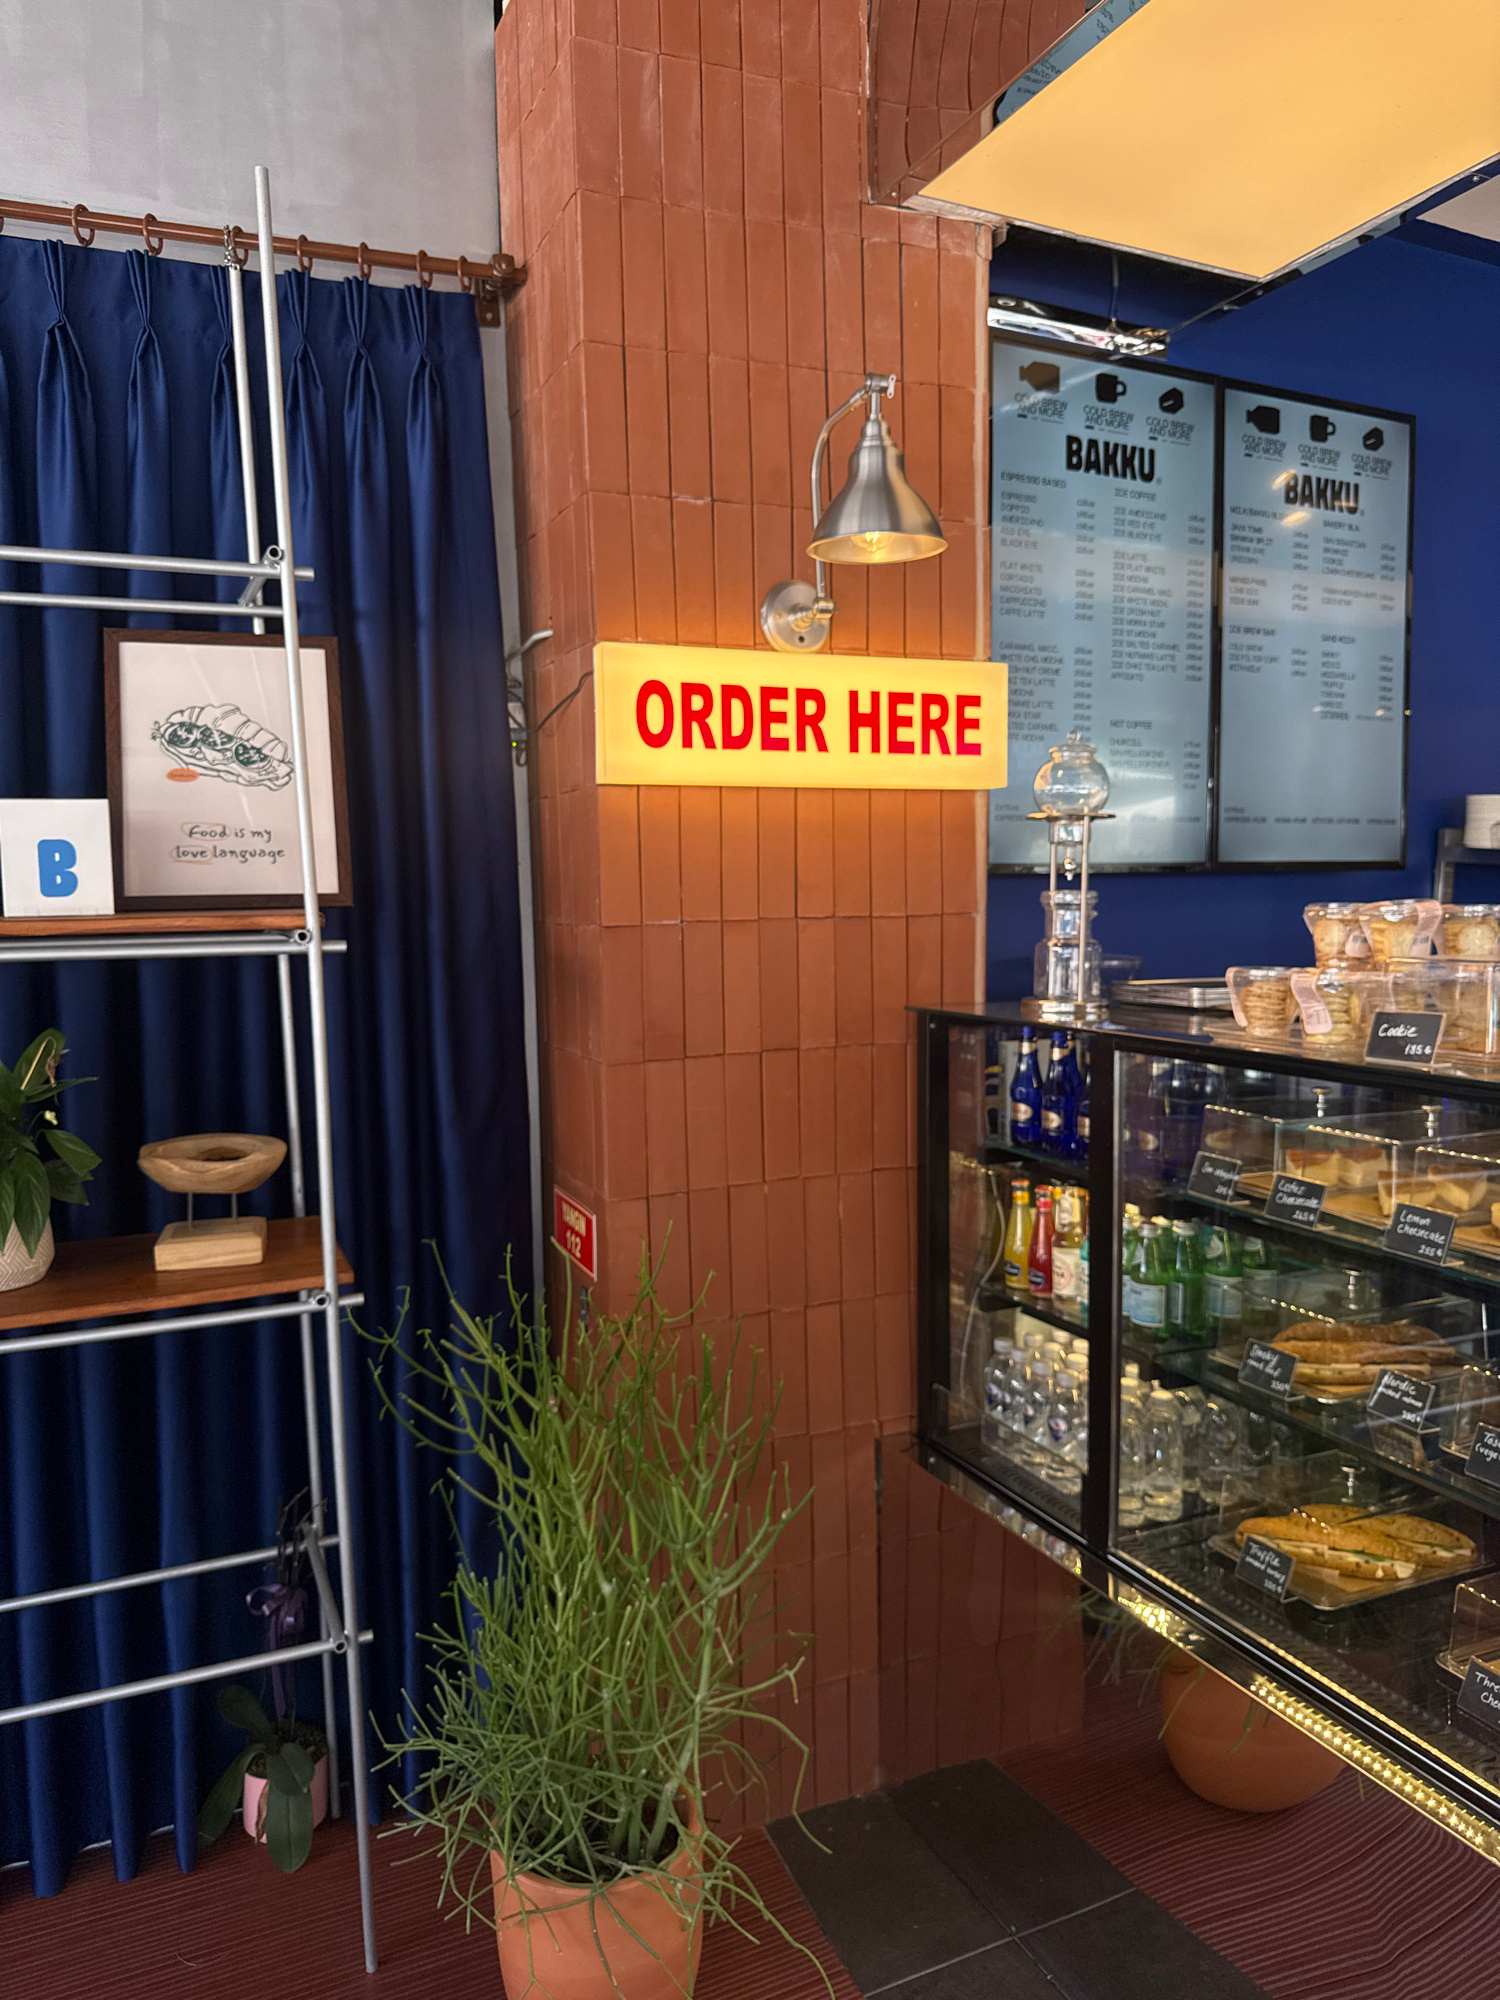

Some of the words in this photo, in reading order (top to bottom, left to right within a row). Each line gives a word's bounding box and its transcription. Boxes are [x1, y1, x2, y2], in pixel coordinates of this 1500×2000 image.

[1018, 403, 1037, 415] AND
[1038, 406, 1064, 419] MORE
[1041, 397, 1068, 411] BREW
[1083, 405, 1109, 417] COLD
[1109, 409, 1134, 422] BREW
[1085, 415, 1105, 426] AND
[1105, 418, 1130, 430] MORE
[1146, 416, 1169, 428] COLD
[1169, 420, 1194, 432] BREW
[1149, 426, 1167, 437] AND
[1168, 429, 1192, 441] MORE
[1242, 433, 1264, 446] COLD
[1264, 438, 1287, 450] BREW
[1066, 434, 1156, 483] BAKKU
[1261, 446, 1284, 457] MORE
[1298, 443, 1318, 456] COLD
[1318, 447, 1341, 459] BREW
[1317, 455, 1338, 467] MORE
[1351, 453, 1371, 464] COLD
[1372, 456, 1393, 468] BREW
[1001, 471, 1041, 485] ESPRESSO
[1041, 477, 1067, 489] BASED
[1284, 473, 1360, 515] BAKKU
[636, 679, 829, 753] ORDER
[848, 690, 982, 757] HERE
[234, 828, 246, 840] is
[250, 829, 273, 844] my
[176, 845, 210, 859] love
[213, 845, 287, 866] language
[37, 839, 78, 897] B
[1378, 1023, 1420, 1039] Cookie
[1399, 1208, 1432, 1227] Lemon
[1396, 1223, 1446, 1245] Cheesecake
[566, 1229, 582, 1259] 112
[1474, 1670, 1500, 1695] Thre
